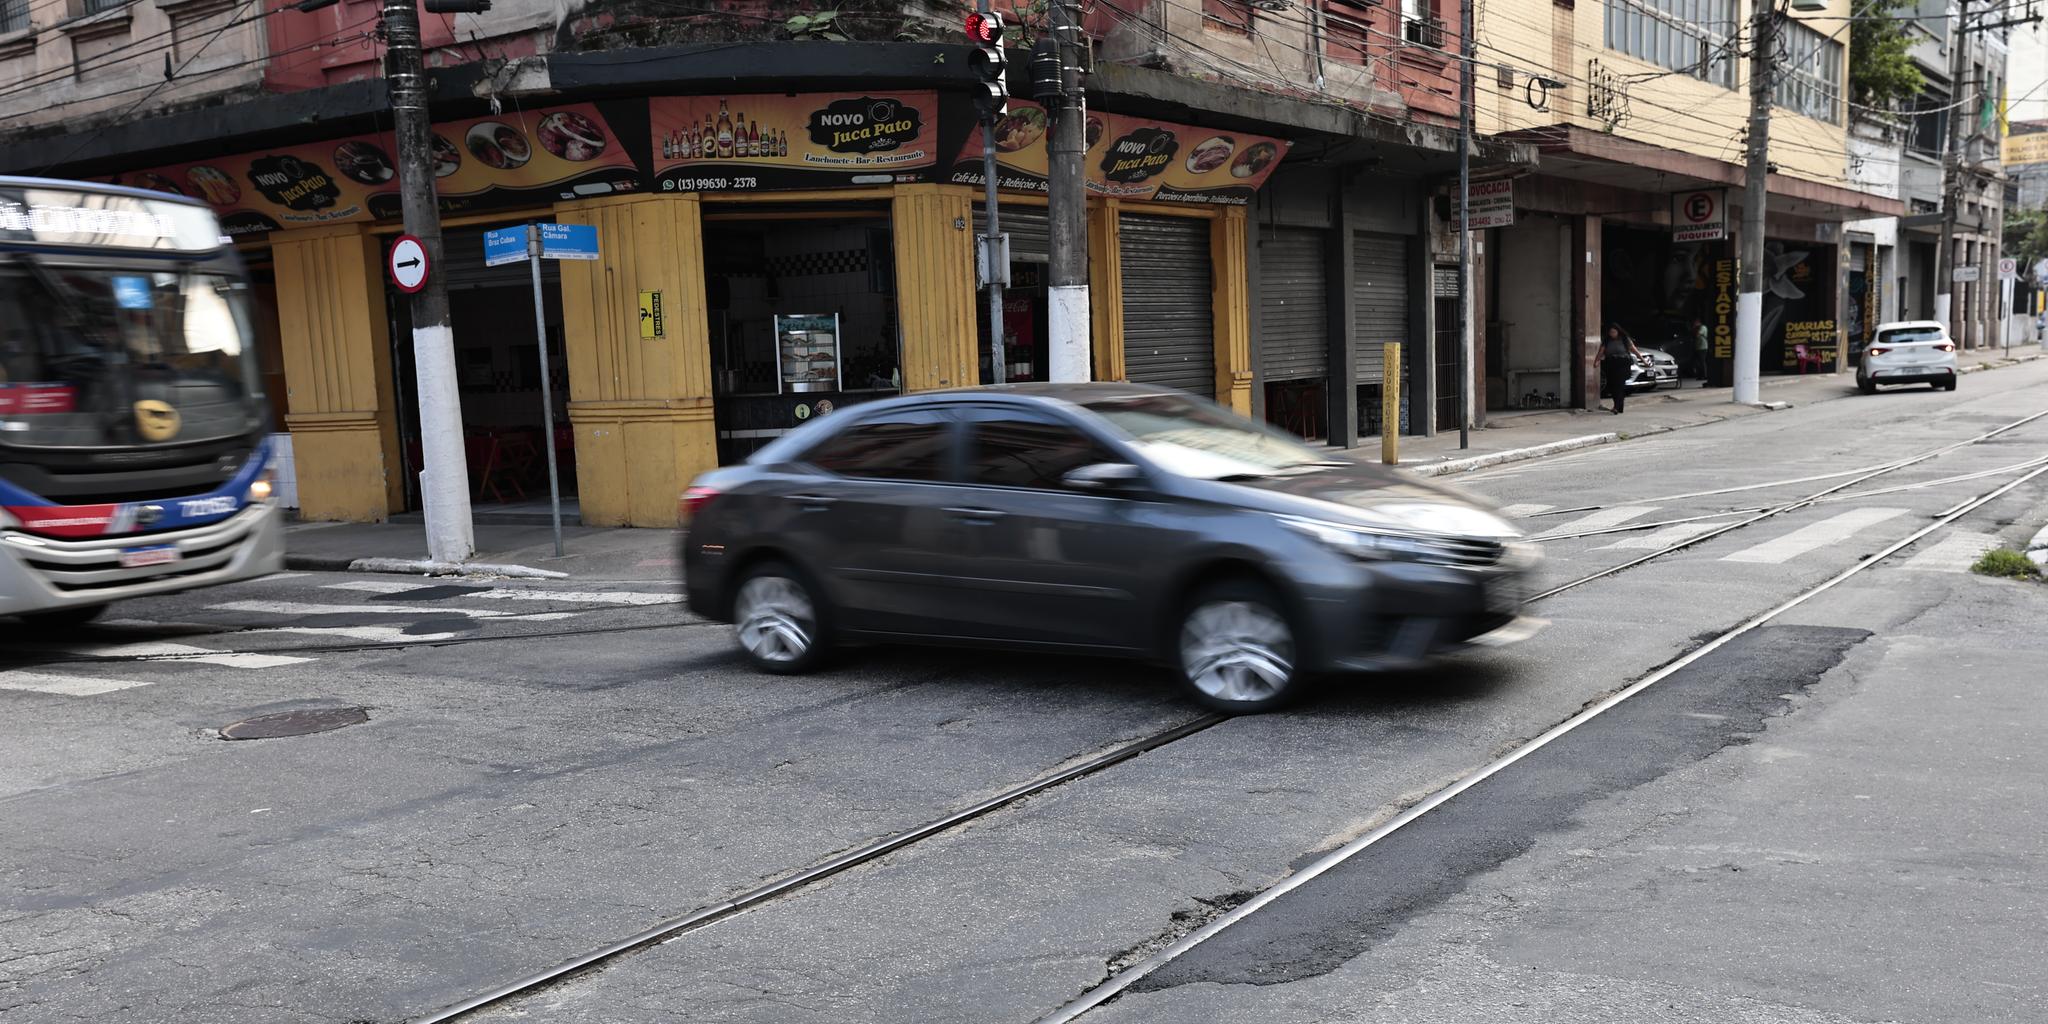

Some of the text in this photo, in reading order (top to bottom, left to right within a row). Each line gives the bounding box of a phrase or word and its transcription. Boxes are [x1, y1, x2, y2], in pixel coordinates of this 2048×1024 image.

[821, 114, 863, 126] NOVO
[832, 120, 912, 147] Juca Pato
[1117, 141, 1145, 155] NOVO
[805, 154, 849, 164] Lanchonete
[856, 156, 870, 164] Bar
[876, 151, 925, 163] Restaurante
[1109, 154, 1169, 175] Juca Pato
[257, 173, 288, 186] NOVO
[678, 178, 695, 190] (13)
[697, 176, 727, 189] 99630
[734, 176, 756, 188] 2378
[952, 171, 969, 182] Café
[969, 173, 977, 183] da
[279, 175, 327, 206] Juca Pato
[1692, 199, 1706, 219] E
[543, 224, 572, 233] Rua Gal.
[488, 231, 499, 240] Rua
[488, 236, 517, 247] Braz Cubas
[543, 231, 568, 240] Câmara
[1677, 230, 1719, 241] JUQUEHY
[1715, 260, 1732, 358] ESTACIONE
